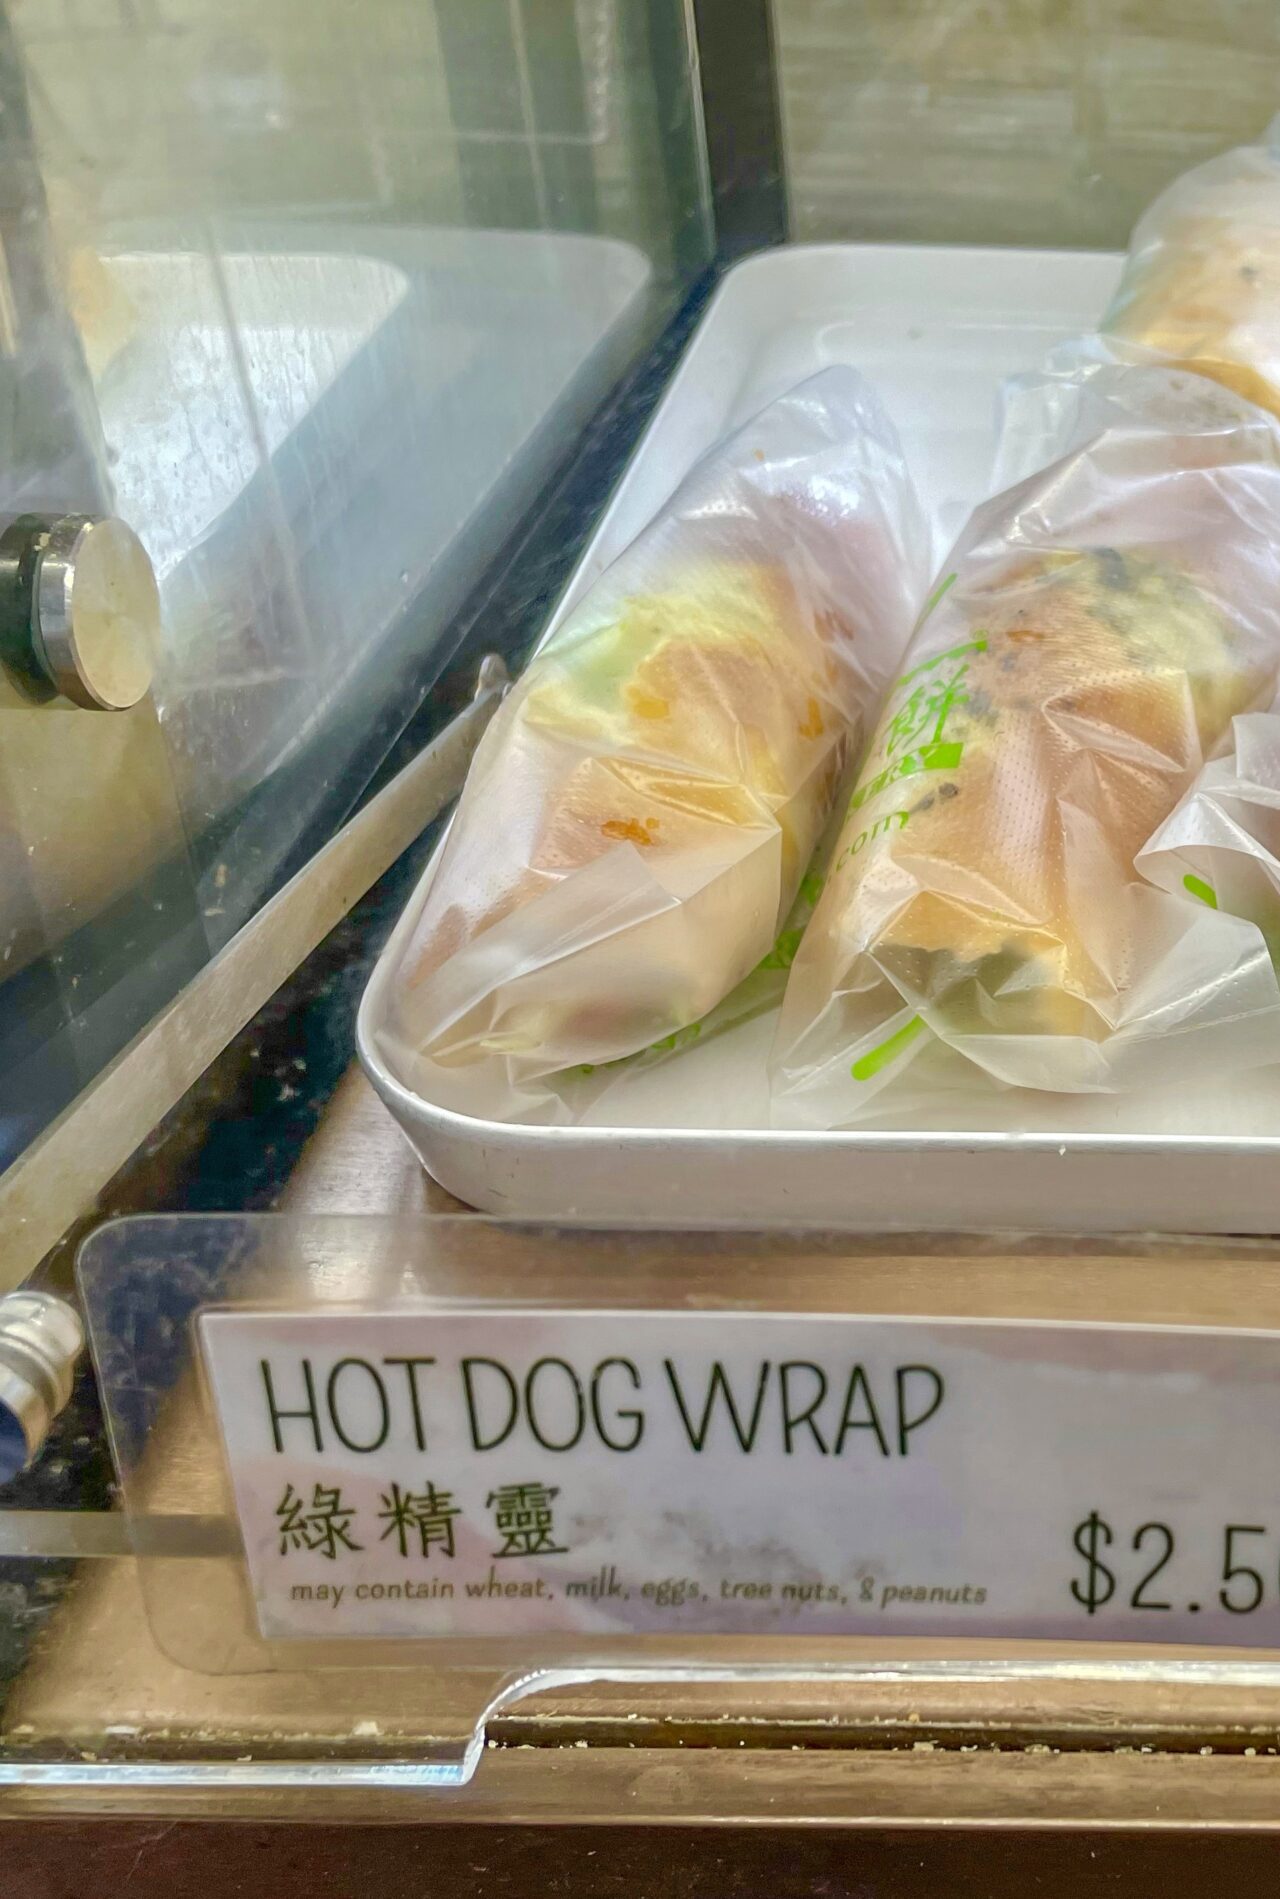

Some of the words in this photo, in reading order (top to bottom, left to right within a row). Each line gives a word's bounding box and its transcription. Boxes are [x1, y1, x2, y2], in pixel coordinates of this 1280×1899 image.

[260, 1357, 436, 1453] HOT
[460, 1356, 646, 1452] DOG
[664, 1358, 946, 1457] WRAP
[274, 1480, 570, 1560] 綠精靈
[291, 1583, 344, 1608] may
[356, 1577, 454, 1600] contain
[466, 1566, 554, 1600] wheat,
[566, 1566, 630, 1602] milk,
[640, 1577, 709, 1606] eggs,
[720, 1578, 772, 1599] tree
[781, 1580, 847, 1606] nuts,
[881, 1583, 988, 1609] peanuts
